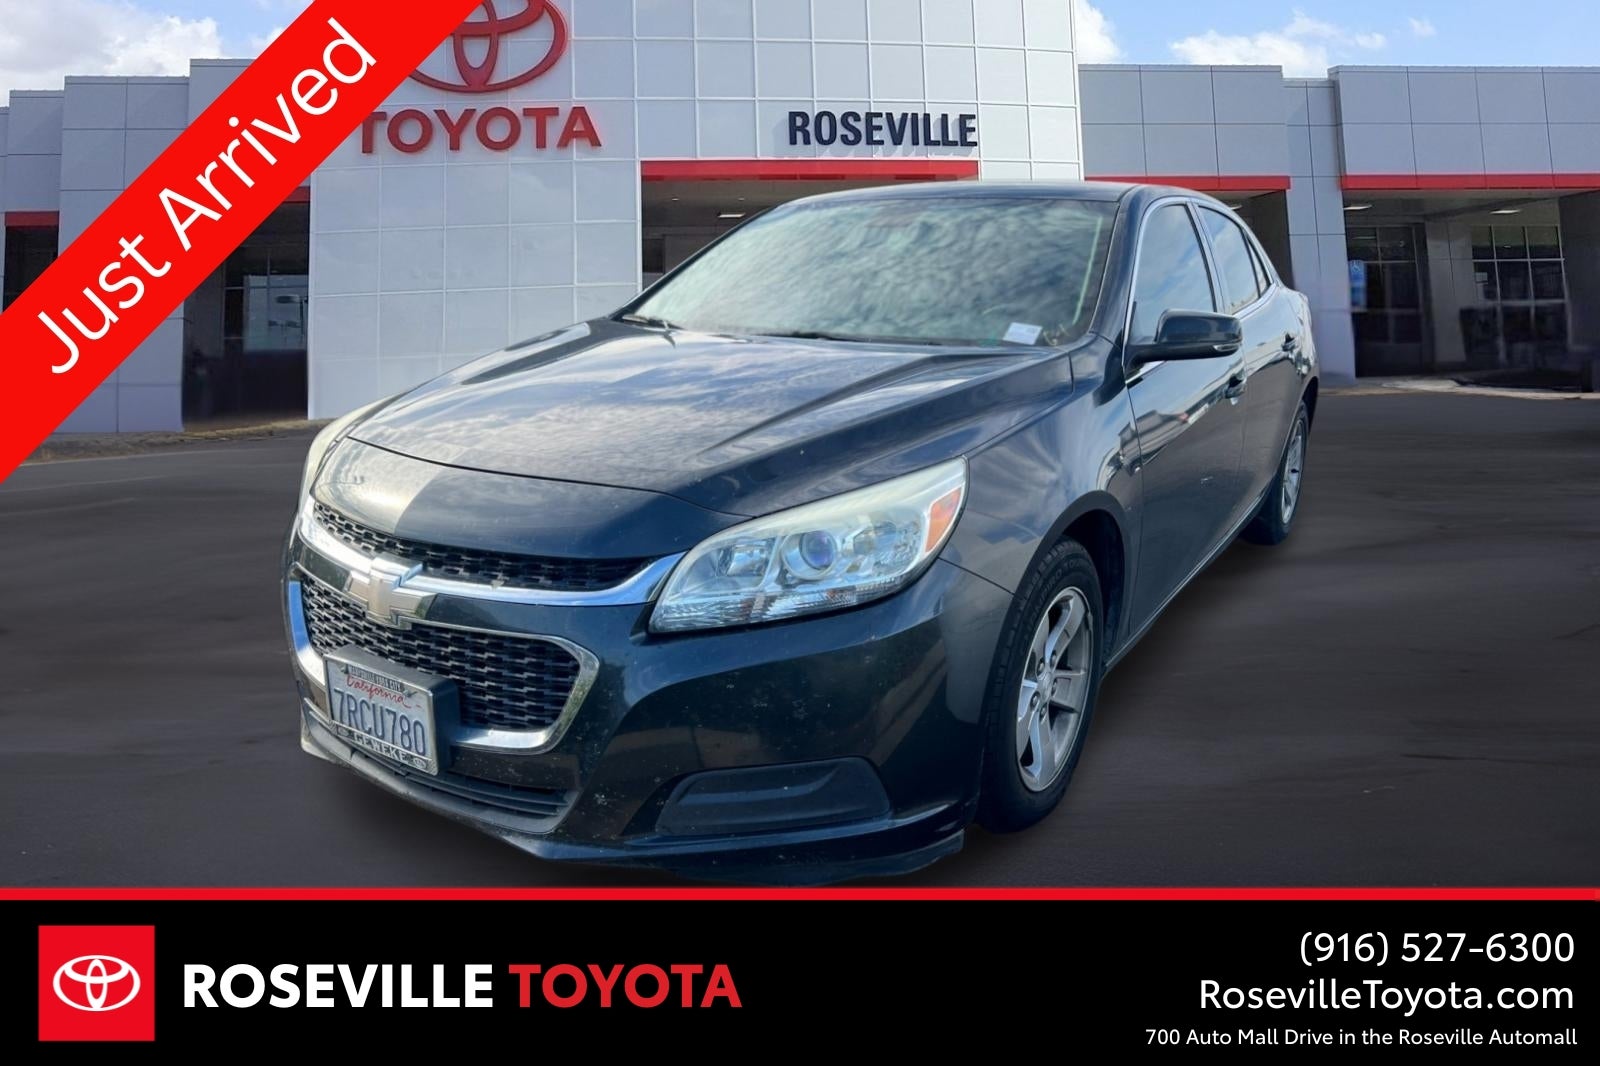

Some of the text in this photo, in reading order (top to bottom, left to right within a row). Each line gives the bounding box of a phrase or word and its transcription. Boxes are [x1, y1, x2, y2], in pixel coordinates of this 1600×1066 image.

[361, 106, 603, 154] TOYOTA
[788, 110, 978, 147] ROSEVILLE
[346, 673, 411, 709] California
[334, 687, 426, 756] 7RCU780
[353, 732, 408, 763] GEWEKE
